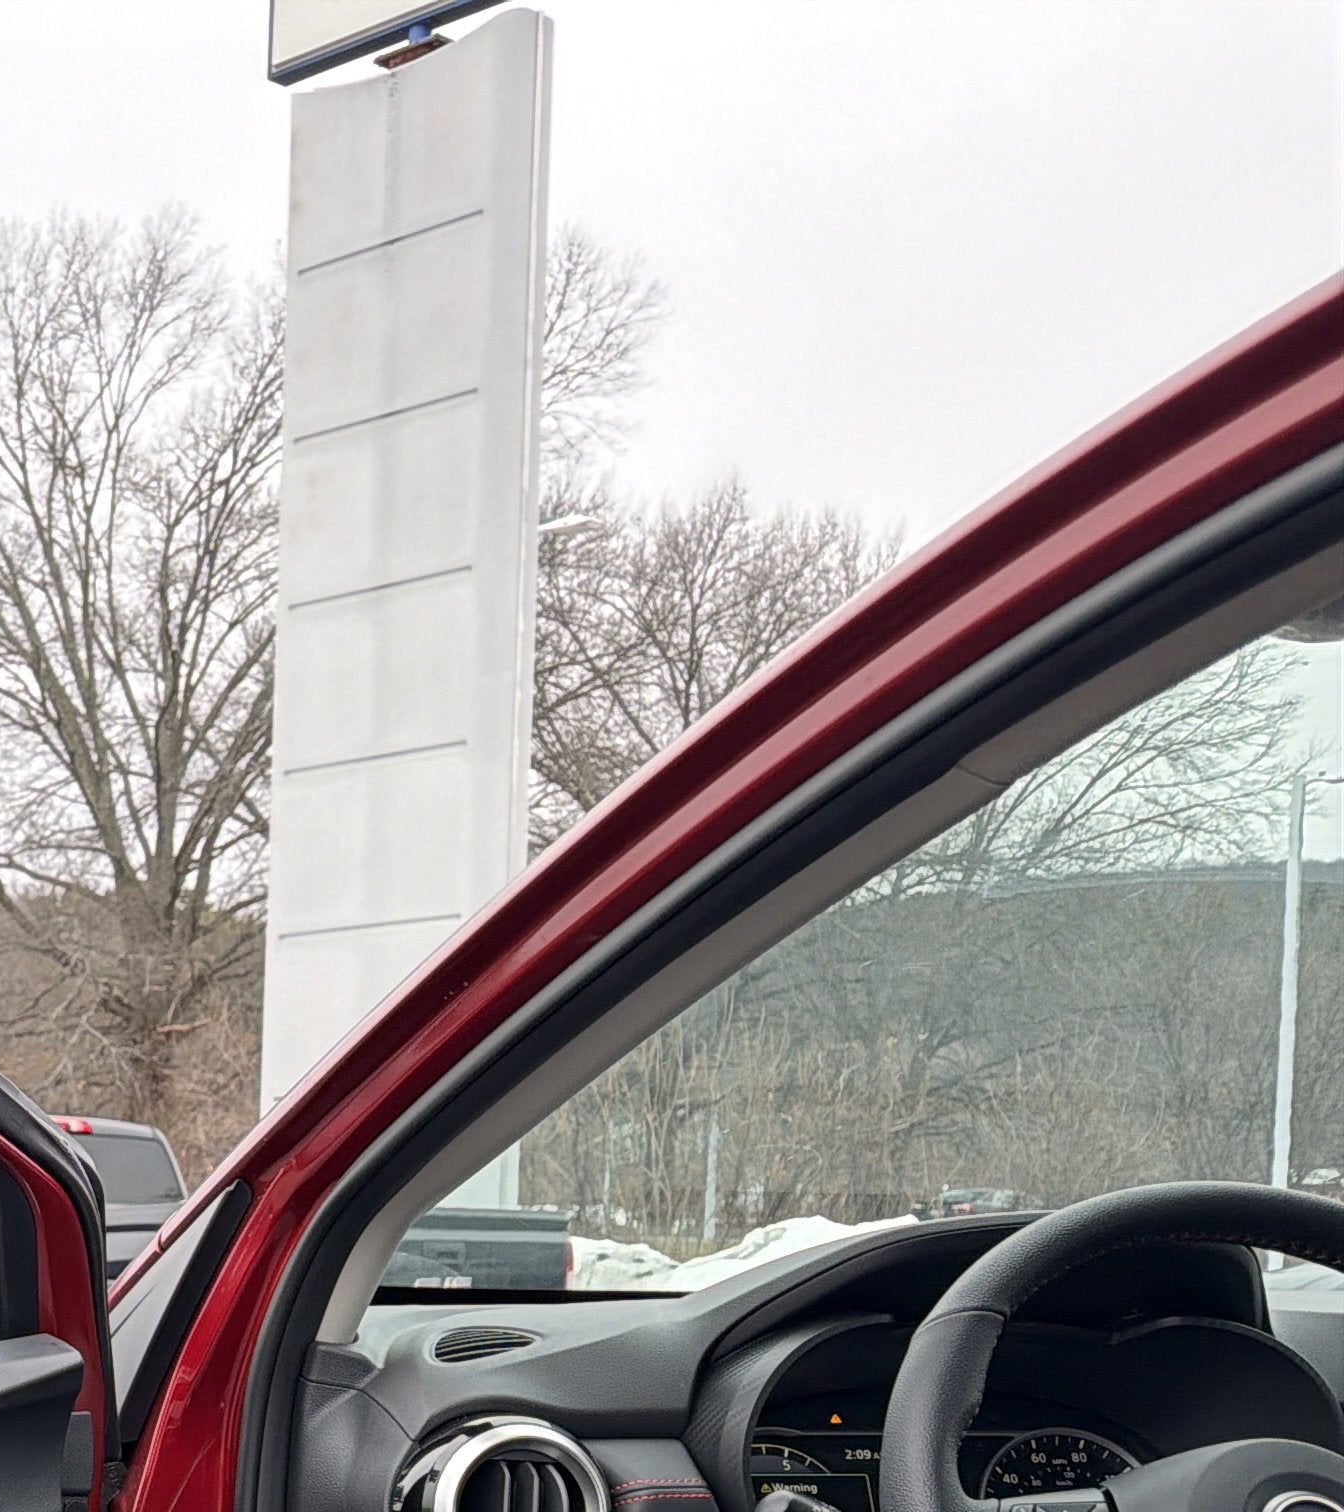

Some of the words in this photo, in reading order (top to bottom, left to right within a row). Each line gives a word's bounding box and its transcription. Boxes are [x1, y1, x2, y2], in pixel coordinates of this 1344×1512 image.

[844, 1448, 872, 1460] 2:09
[1031, 1452, 1047, 1464] 60
[1071, 1452, 1087, 1463] 80
[782, 1459, 791, 1471] 5
[1002, 1473, 1019, 1484] 40
[771, 1482, 818, 1495] Warning
